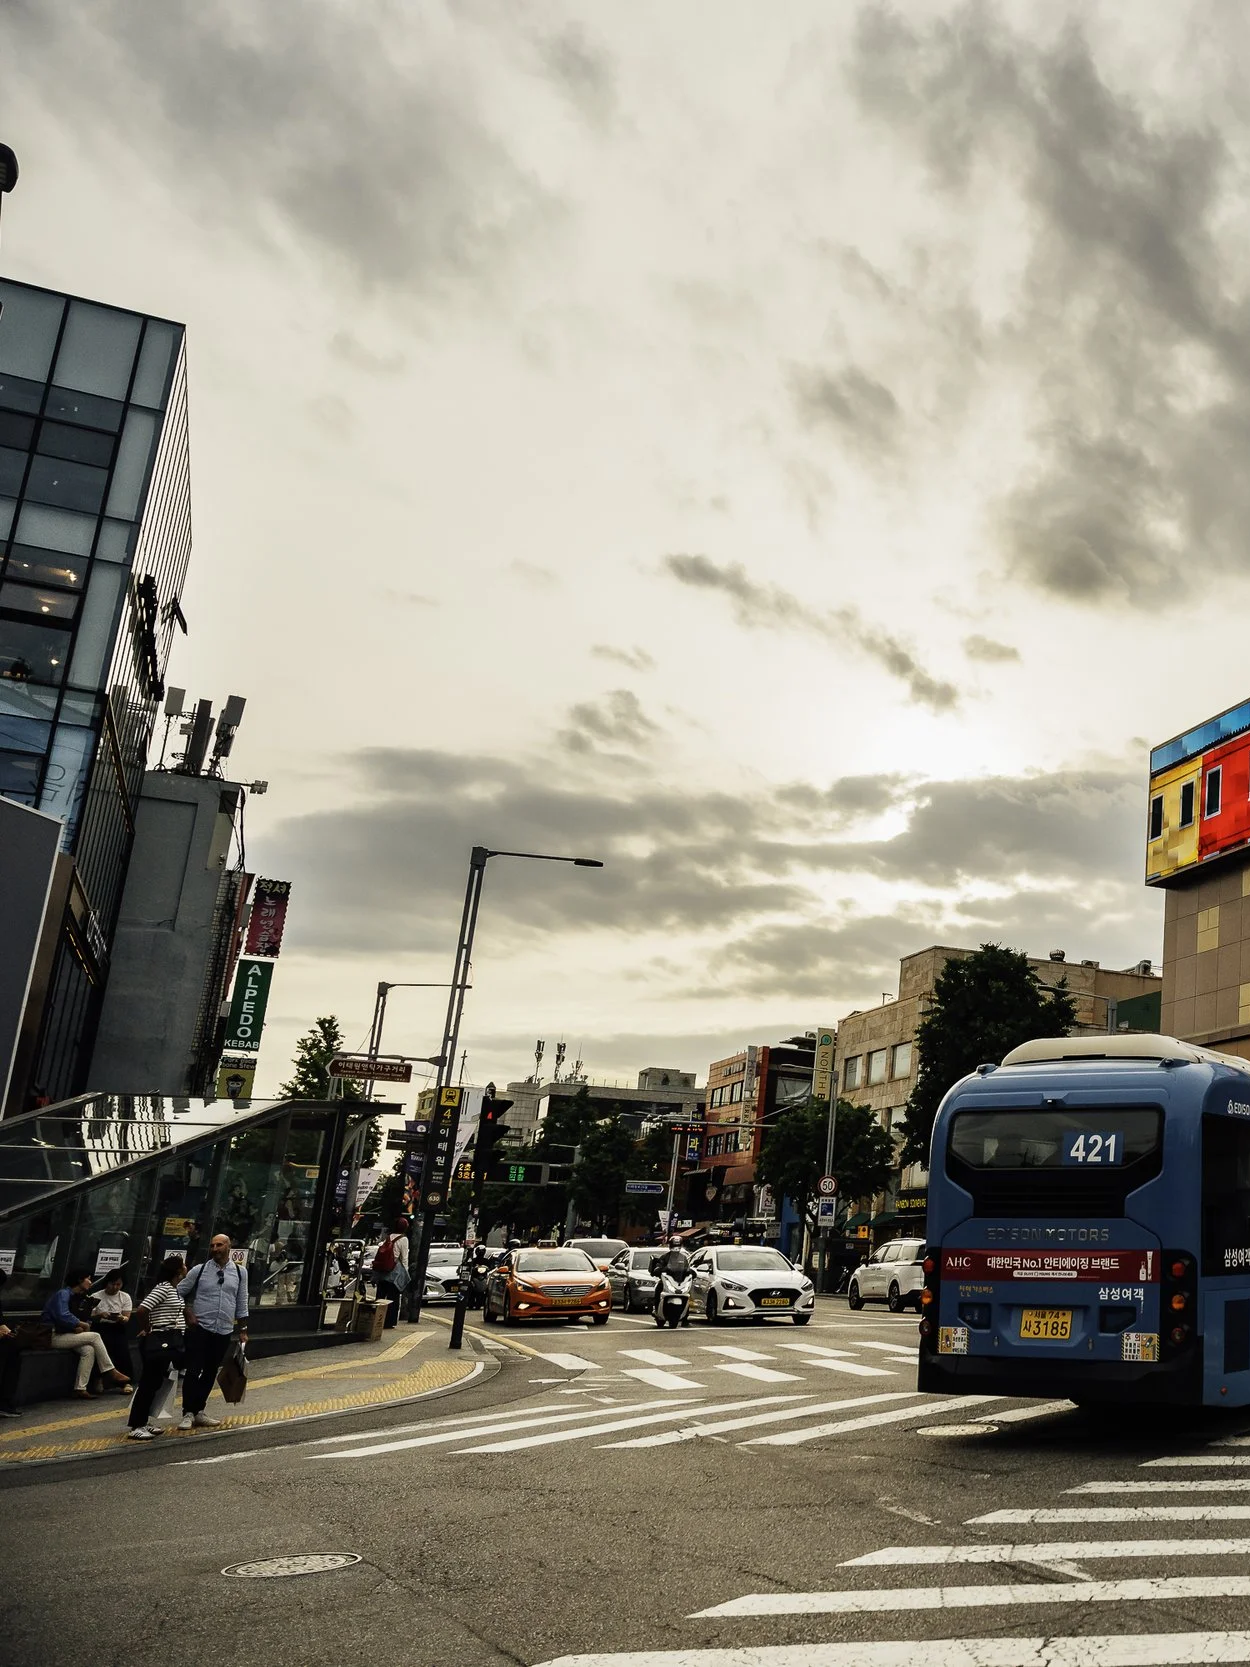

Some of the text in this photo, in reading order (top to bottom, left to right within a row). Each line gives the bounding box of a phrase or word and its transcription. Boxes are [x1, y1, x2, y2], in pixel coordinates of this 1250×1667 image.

[236, 964, 262, 1039] ALPEDO
[224, 1039, 259, 1049] KEBAB
[818, 1051, 829, 1089] NORTH
[443, 1109, 453, 1119] 4
[435, 1127, 450, 1166] 이태원
[1070, 1133, 1117, 1163] 421
[822, 1181, 834, 1191] 50
[1046, 1228, 1110, 1241] MOTORS
[946, 1256, 971, 1267] AHC
[987, 1256, 1120, 1270] 대한민국 No.1 안티에이징 브랜드
[1224, 1249, 1250, 1268] 삼성여객
[1098, 1288, 1144, 1301] 삼성여객
[1034, 1311, 1060, 1319] 서울 74
